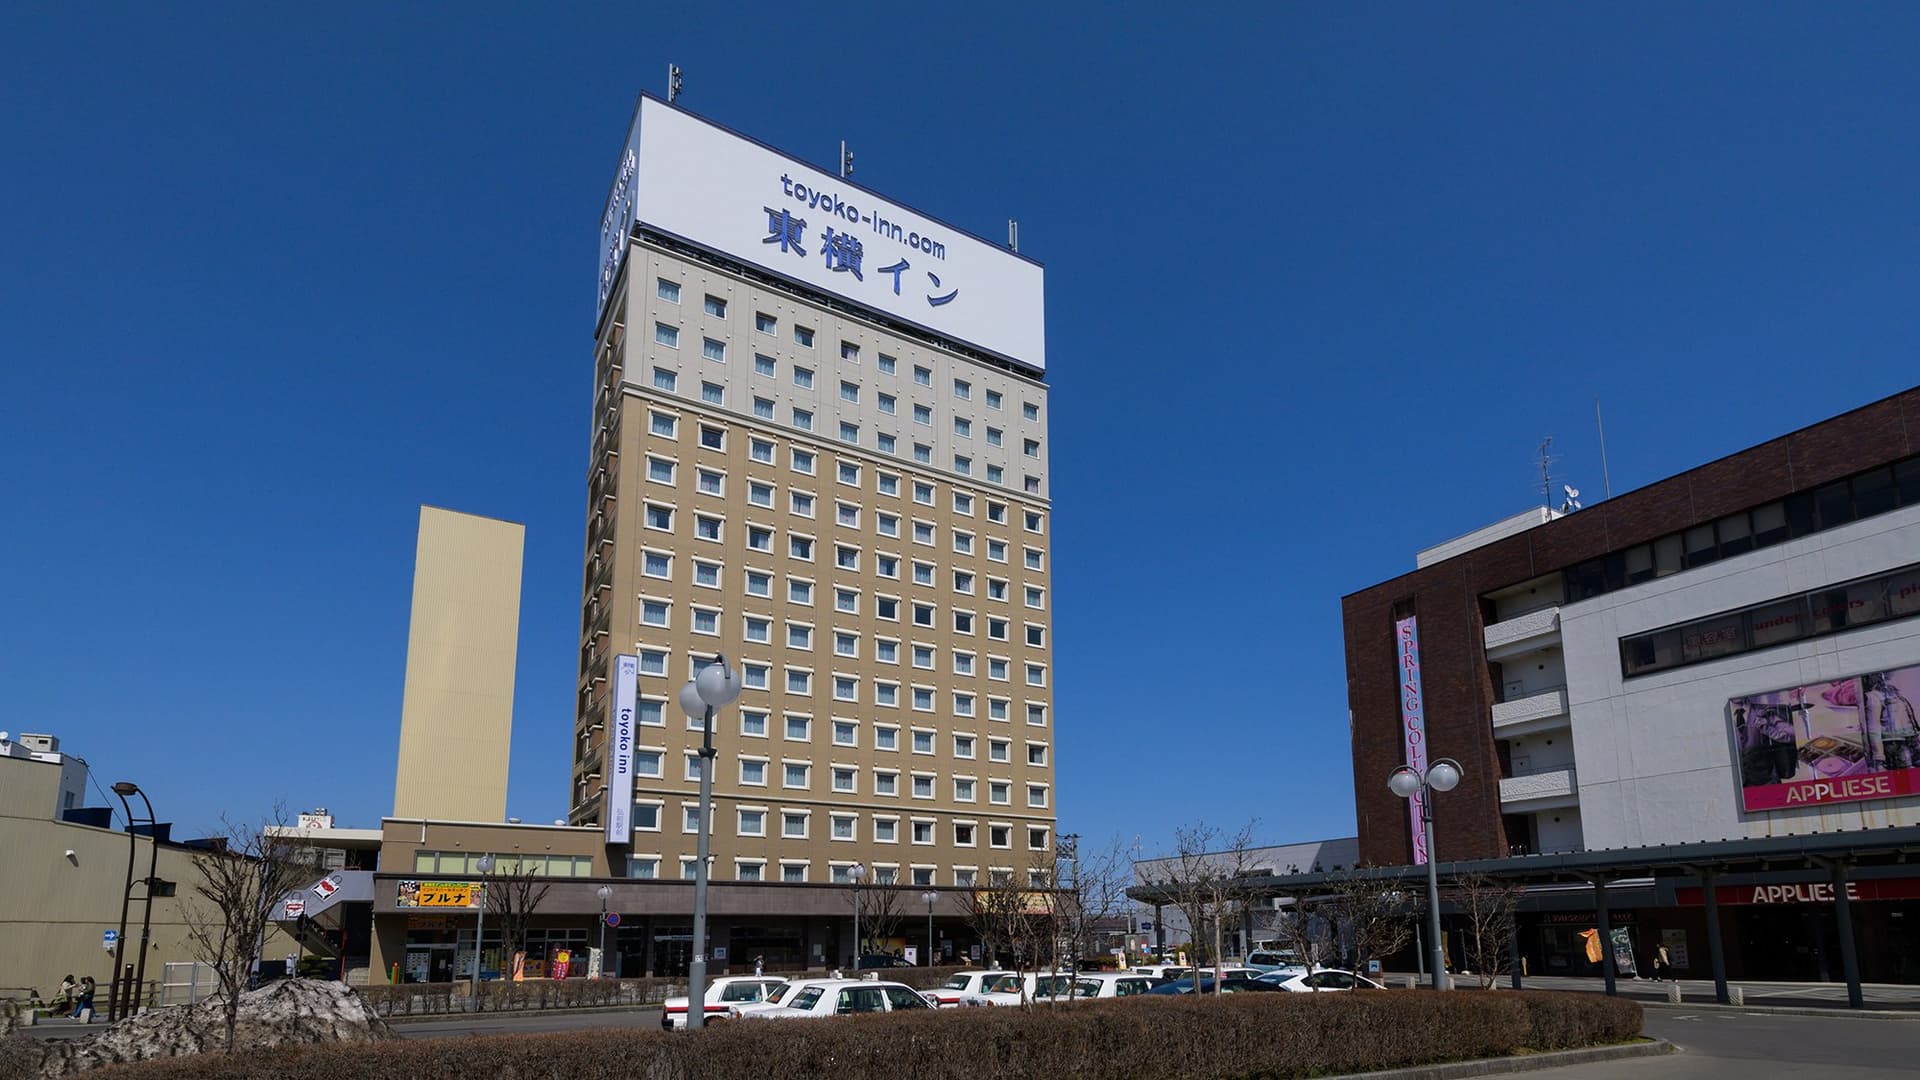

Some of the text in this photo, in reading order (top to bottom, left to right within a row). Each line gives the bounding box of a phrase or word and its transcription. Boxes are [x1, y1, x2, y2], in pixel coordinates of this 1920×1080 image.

[762, 206, 959, 307] 東横イン
[781, 174, 945, 260] toyoko-inn.com
[618, 708, 632, 774] toyoko inn
[1402, 625, 1428, 863] SPRING COLLCTION
[1786, 776, 1891, 804] APPLIESE
